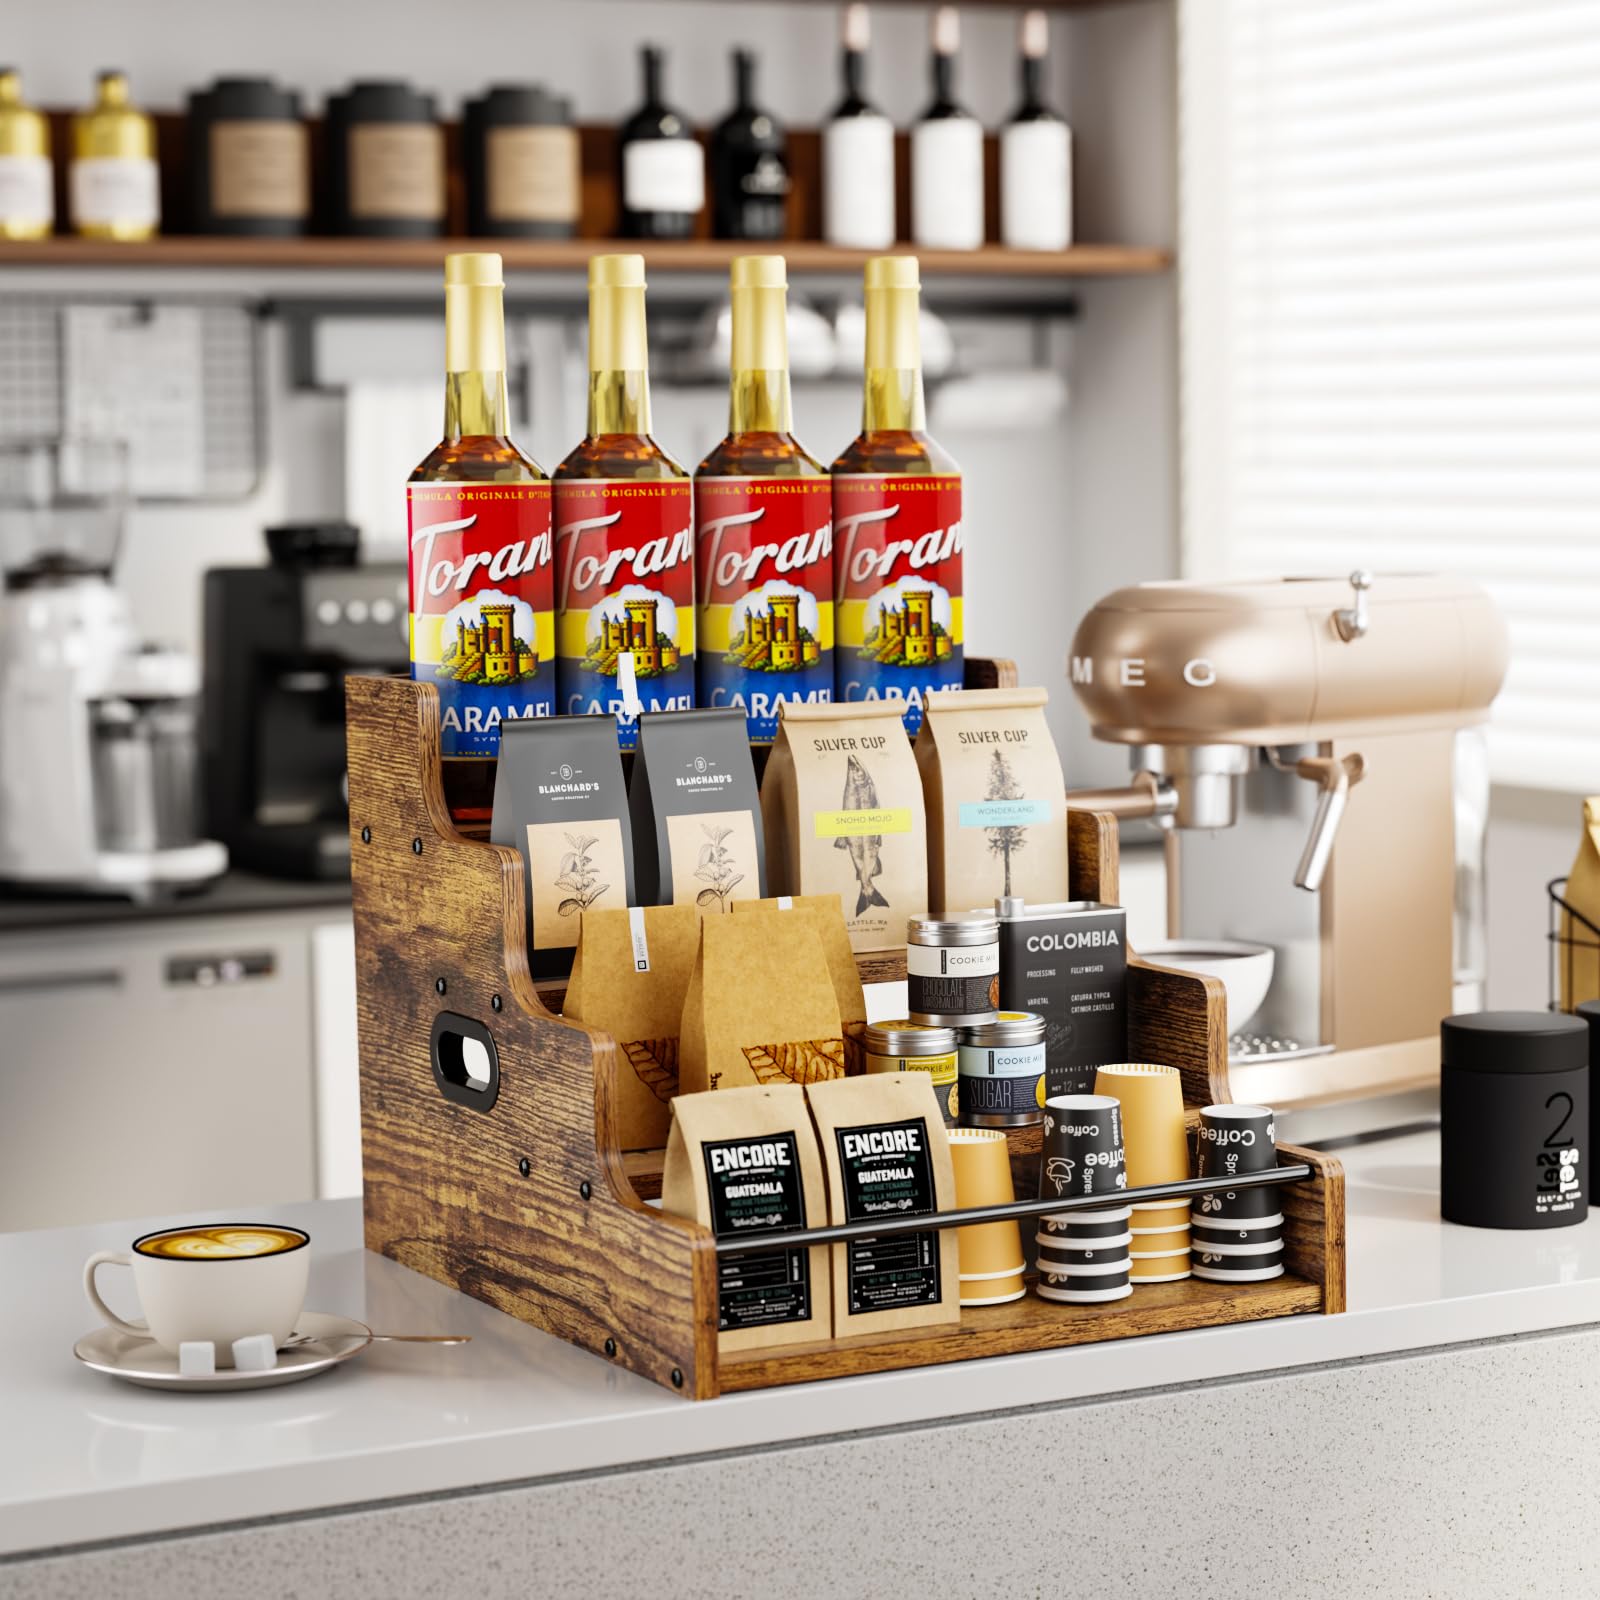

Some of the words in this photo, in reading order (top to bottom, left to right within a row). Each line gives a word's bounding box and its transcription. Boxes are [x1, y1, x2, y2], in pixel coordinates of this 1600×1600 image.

[456, 490, 525, 501] ORIGINALE
[602, 487, 668, 498] ORIGINALE
[1071, 655, 1217, 687] MEG
[813, 738, 858, 752] SILVER
[860, 736, 886, 750] CUP
[957, 730, 1002, 745] SILVER
[1003, 729, 1029, 743] CUP
[538, 782, 600, 794] BLANCHARD'S
[675, 774, 733, 786] BLANCHARD'S
[976, 805, 1035, 816] WONDERLAND
[1026, 929, 1120, 953] COLOMBIA
[949, 955, 984, 965] COOKIE
[1026, 968, 1057, 979] PROCESSING
[1070, 966, 1084, 975] FULLY
[1084, 964, 1104, 974] WASHED
[997, 1056, 1031, 1066] COOKIE
[970, 1079, 1012, 1109] SUGAR
[1543, 1091, 1574, 1149] 2
[1060, 1124, 1100, 1137] Coffee
[1200, 1127, 1256, 1147] Coffee
[843, 1128, 921, 1159] ENCORE
[710, 1142, 791, 1173] ENCORE
[1084, 1148, 1124, 1169] offee
[858, 1166, 915, 1185] GUATEMALA
[725, 1181, 784, 1200] GUATEMALA
